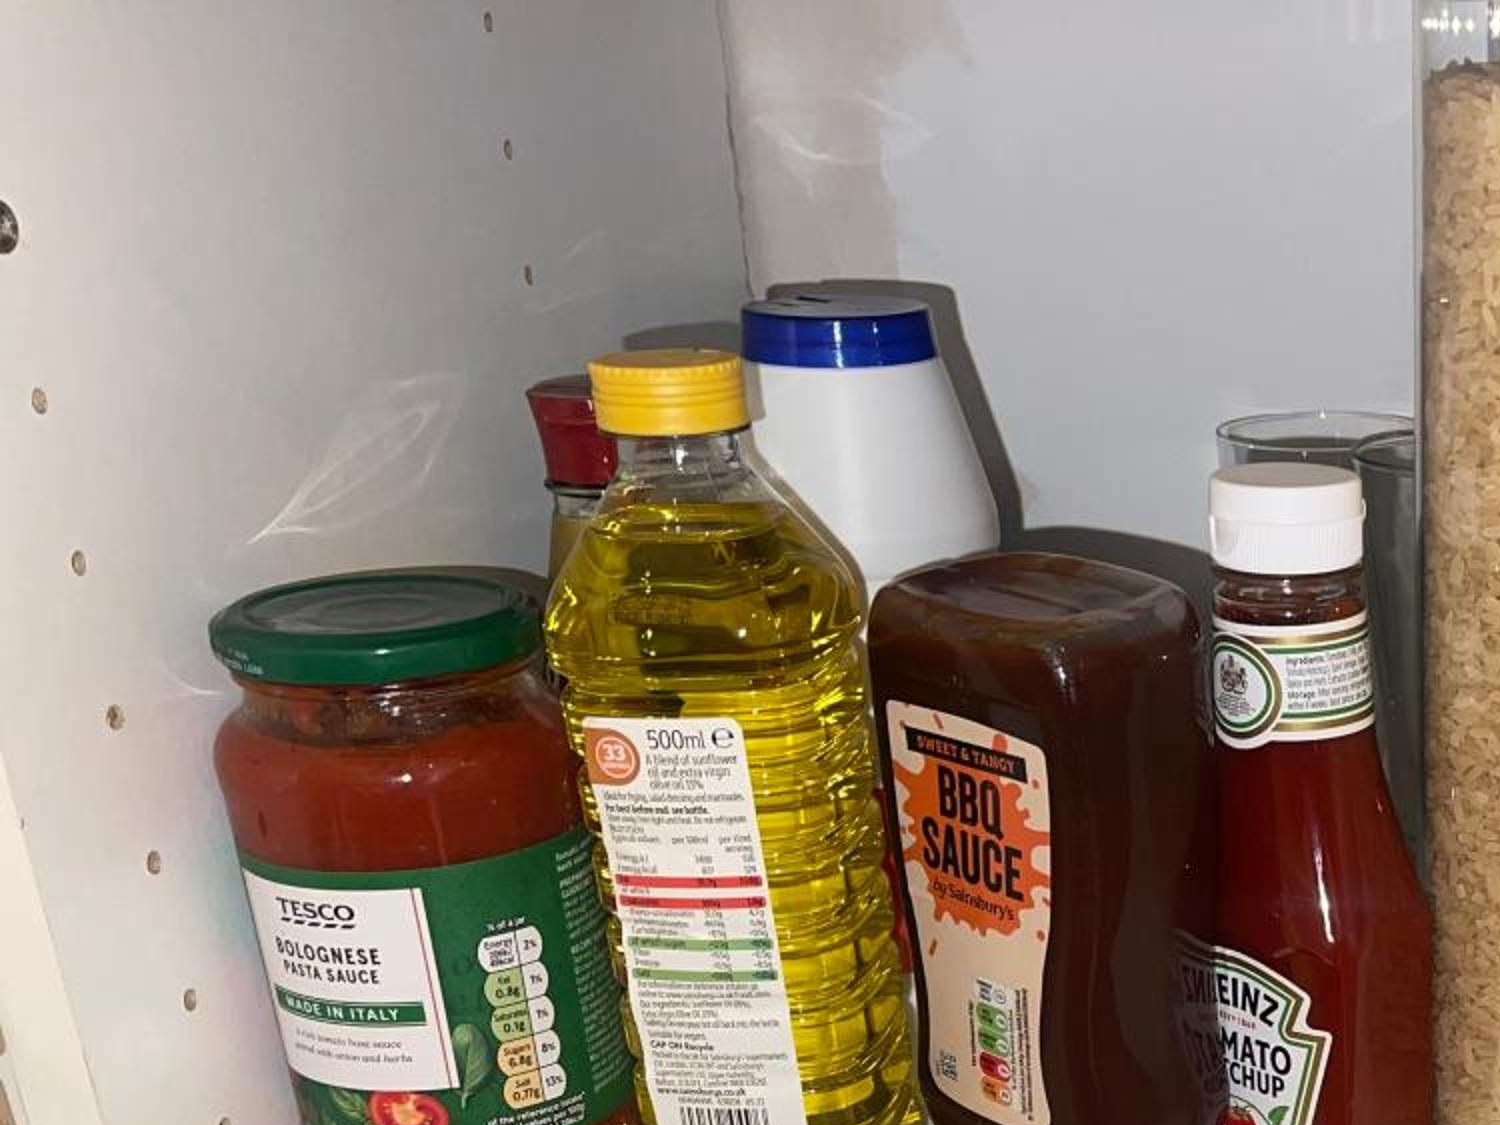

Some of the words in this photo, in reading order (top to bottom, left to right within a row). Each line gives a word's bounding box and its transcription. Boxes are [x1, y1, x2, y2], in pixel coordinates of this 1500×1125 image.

[645, 729, 706, 750] 500ml
[917, 735, 958, 757] SWEET
[961, 748, 969, 761] &
[973, 750, 1015, 774] TANGY
[938, 765, 1004, 840] BBQ
[922, 816, 1024, 902] SAUCE
[275, 896, 355, 922] TESCO
[932, 877, 946, 898] by
[949, 885, 1015, 922] Sainsbury's
[275, 936, 381, 966] BOLOGNESE
[284, 959, 322, 981] PASTA
[327, 968, 380, 984] SAUCE
[286, 994, 322, 1016] MADE
[327, 1005, 343, 1019] IN
[351, 1008, 399, 1021] ITALY
[1217, 973, 1279, 1026] EINZ
[503, 1021, 526, 1033] 0.1g
[362, 1053, 380, 1063] and
[541, 1042, 557, 1053] 8%
[650, 1039, 667, 1049] CAP
[667, 1040, 683, 1050] ON
[684, 1041, 714, 1053] Recycle
[1220, 1027, 1291, 1076] MATO
[508, 1055, 532, 1067] 6.8g
[546, 1075, 563, 1087] 13%
[1224, 1057, 1285, 1098] CHUP
[513, 1088, 540, 1100] 0.77g
